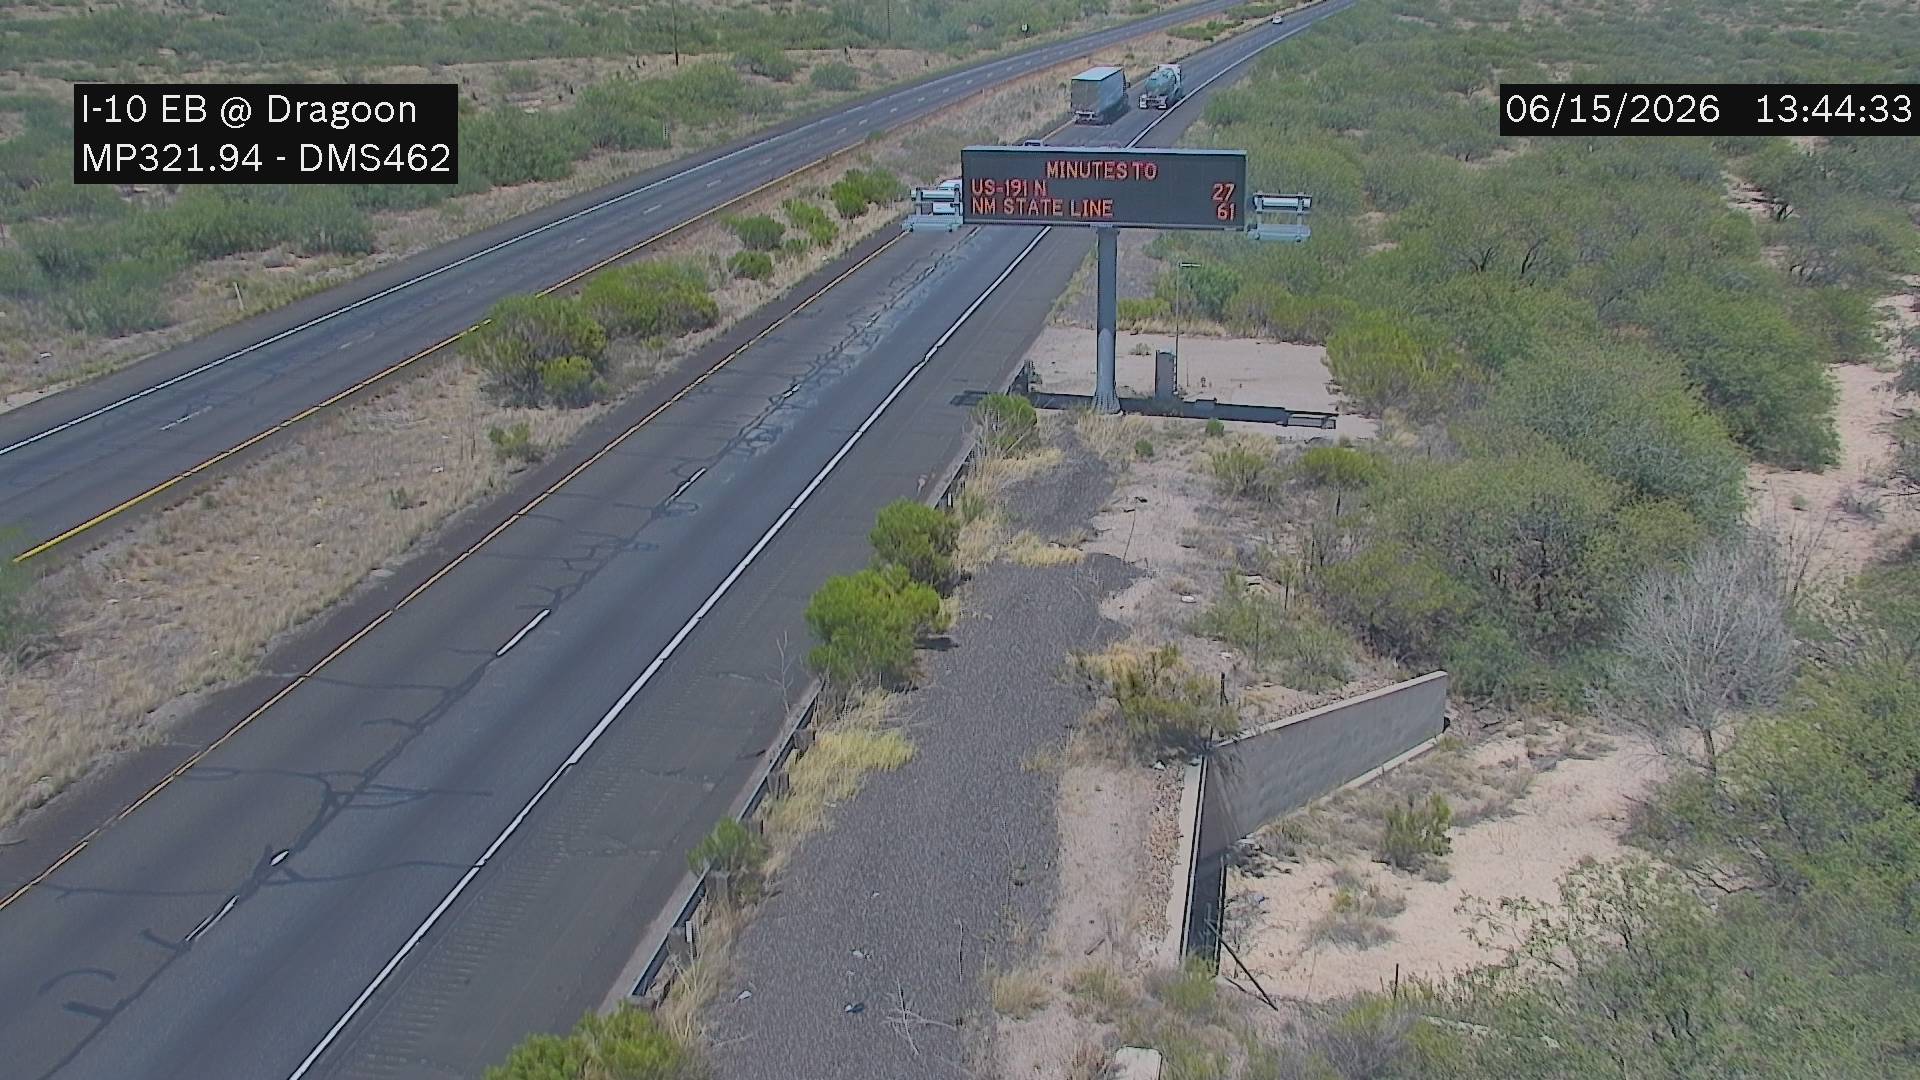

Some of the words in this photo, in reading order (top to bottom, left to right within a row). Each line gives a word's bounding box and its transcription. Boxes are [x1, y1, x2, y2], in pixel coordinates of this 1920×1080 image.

[1046, 161, 1128, 179] MINUTES
[1132, 162, 1157, 180] TO
[971, 179, 1027, 197] US-191
[1034, 179, 1047, 197] N
[1213, 183, 1235, 201] 27
[972, 197, 996, 215] NM
[1003, 198, 1063, 217] STATE
[1070, 199, 1113, 217] LINE
[1217, 203, 1235, 220] 61
